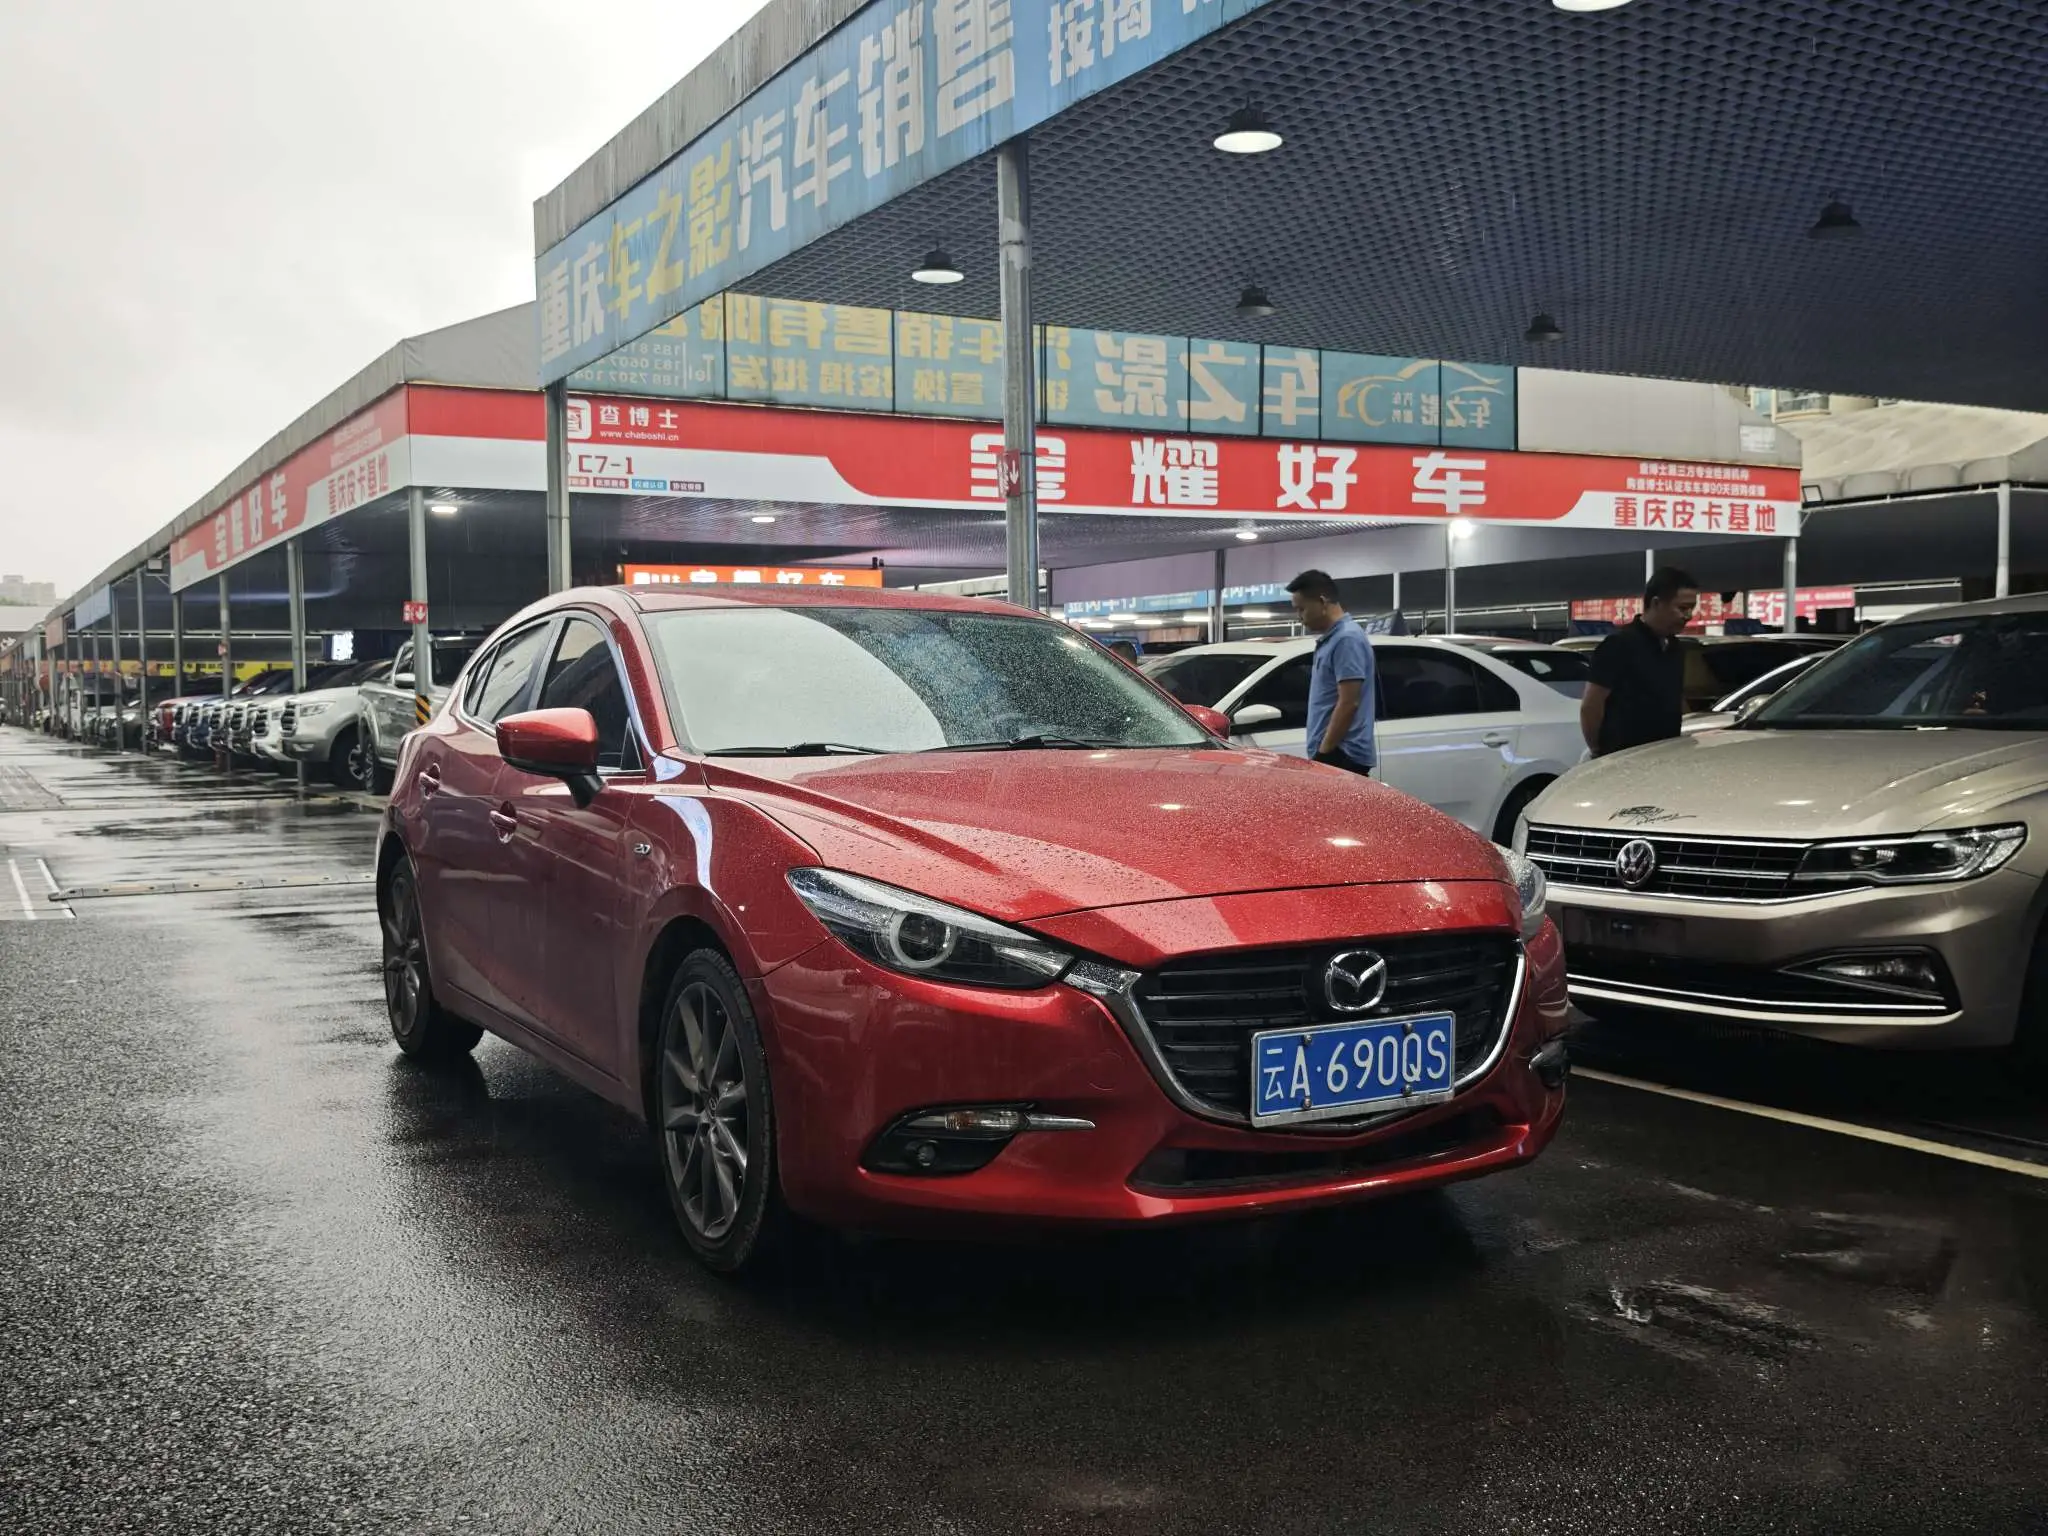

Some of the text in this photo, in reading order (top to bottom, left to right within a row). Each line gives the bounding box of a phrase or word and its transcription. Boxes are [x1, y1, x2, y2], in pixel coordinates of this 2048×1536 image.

[540, 0, 1015, 365] 重庆车之影汽车销售
[599, 404, 679, 429] 查博士
[578, 454, 634, 475] C7-1
[1615, 497, 1776, 533] 重庆皮卡基地
[1263, 1029, 1447, 1101] 云A·690QS
